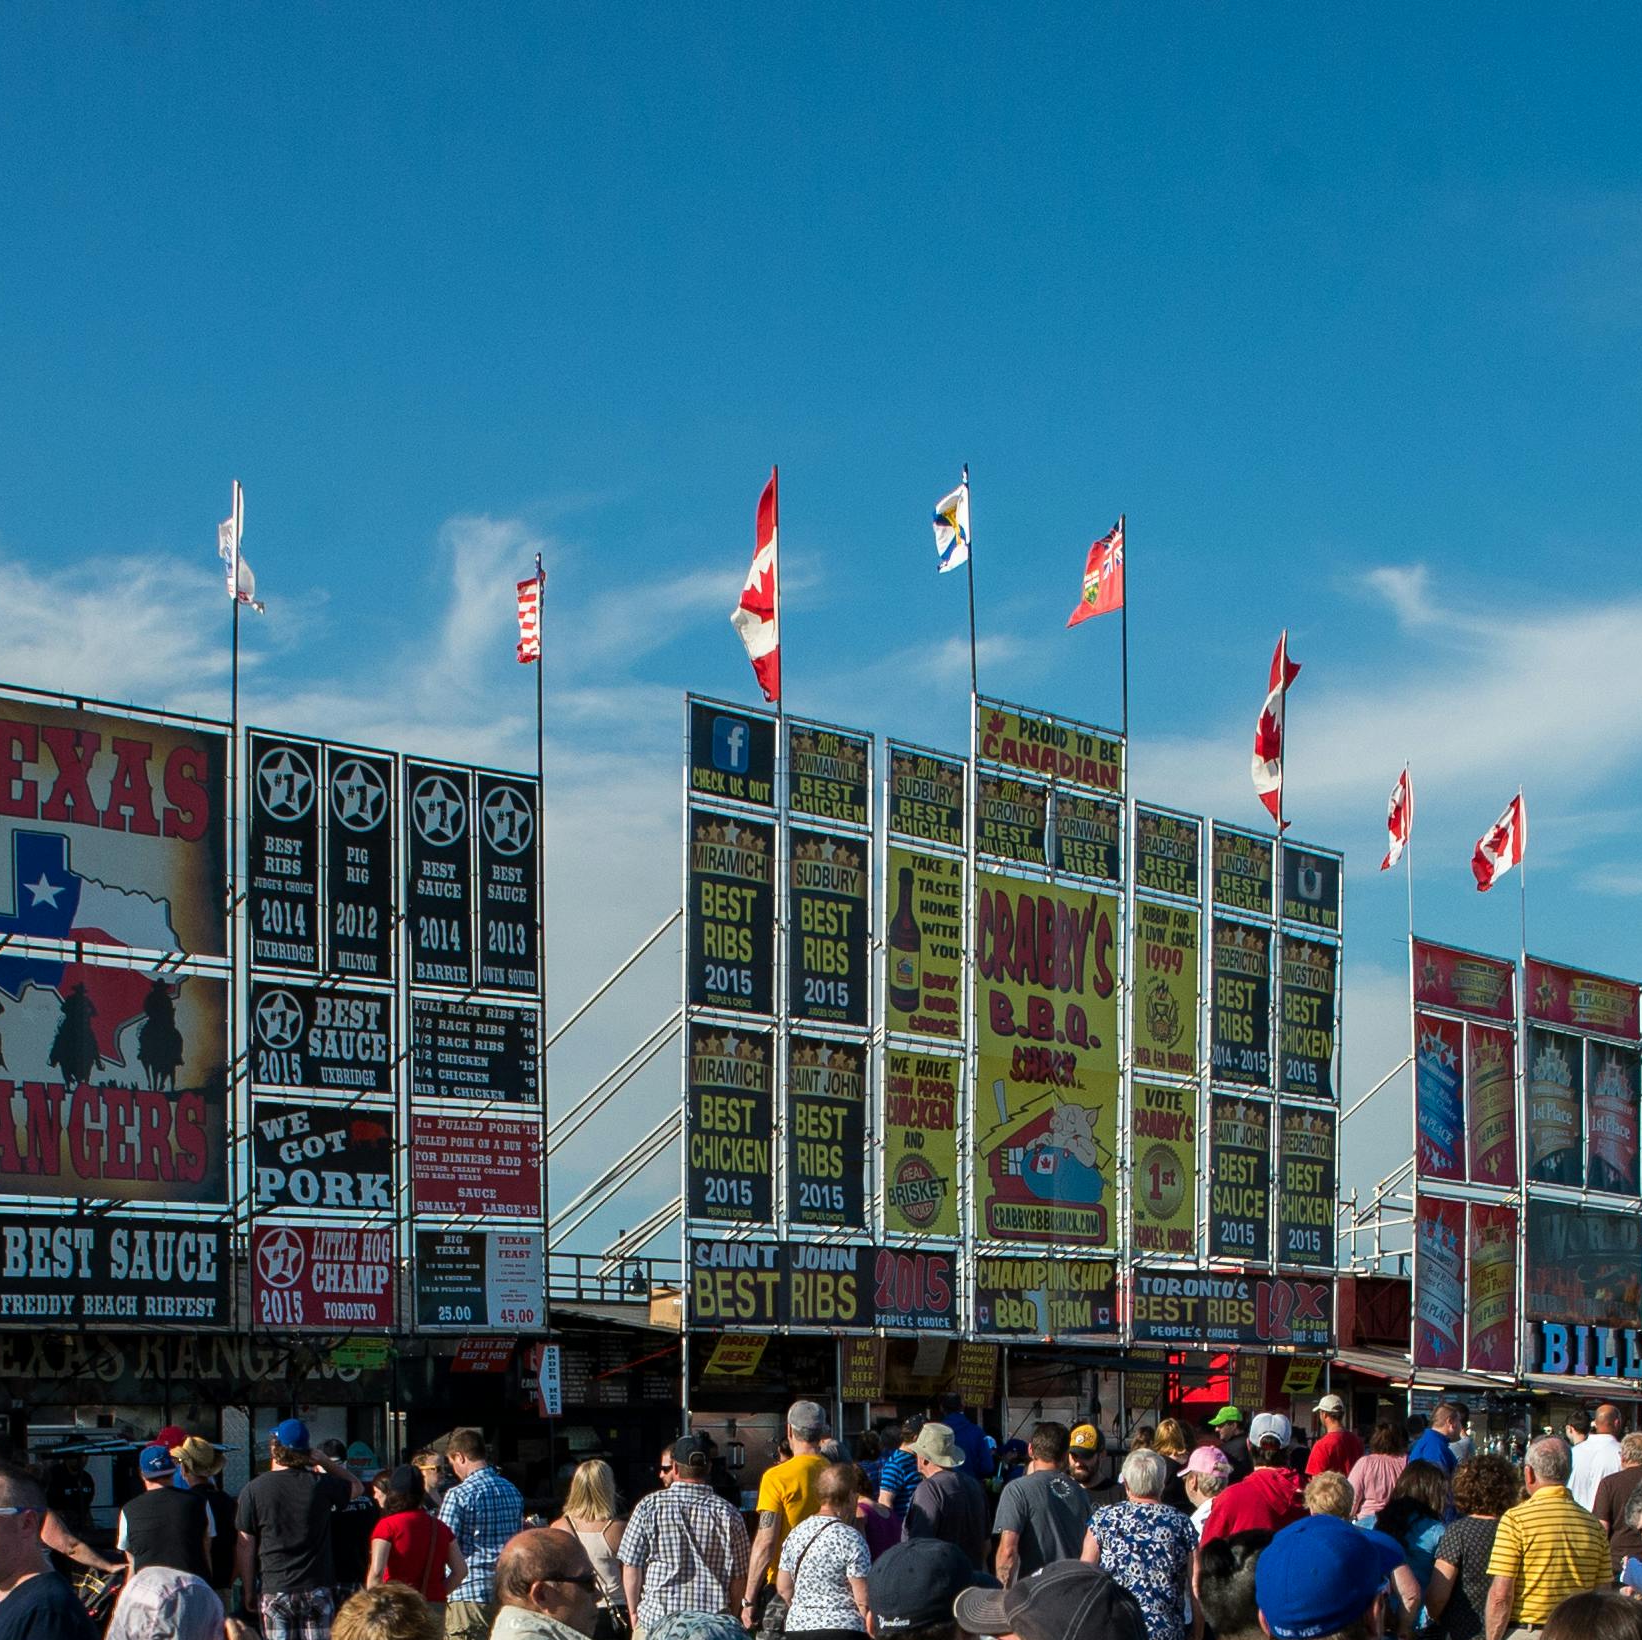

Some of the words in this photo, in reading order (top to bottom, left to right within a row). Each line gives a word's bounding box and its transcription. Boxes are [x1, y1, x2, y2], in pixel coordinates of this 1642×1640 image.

[1018, 715, 1068, 750] PROUD
[1076, 731, 1094, 755] TO
[1099, 739, 1118, 764] BE
[982, 732, 1120, 789] CANADIAN
[692, 767, 726, 792] CHECK
[729, 775, 745, 796] US
[749, 778, 771, 802] OUT
[799, 778, 856, 802] BEST
[791, 791, 867, 823] CHICKEN
[982, 799, 1037, 826] TORONTO
[346, 846, 369, 866] PIG
[693, 843, 771, 881] MIRAMICHI
[1219, 855, 1262, 880] LINDSAY
[346, 866, 370, 886] RIG
[796, 863, 858, 893] SUDBURY
[918, 876, 961, 898] TASTE
[700, 879, 757, 924] BEST
[920, 899, 960, 919] HOME
[336, 901, 378, 940] 2012
[922, 921, 960, 939] WITH
[704, 921, 754, 964] RIBS
[930, 942, 959, 960] YOU
[977, 886, 1115, 1000] CRABBY'S
[337, 951, 378, 973] MILTON
[415, 961, 468, 983] BARRIE
[1145, 942, 1183, 977] 1999
[704, 962, 753, 996] 2015
[315, 996, 382, 1031] BEST
[308, 1028, 388, 1063] SAUCE
[257, 1050, 302, 1086] 2015
[320, 1066, 377, 1087] UXBRIDGE
[1144, 1088, 1183, 1111] VOTE
[258, 1110, 310, 1142] WE
[279, 1129, 348, 1165] GOT
[691, 1135, 768, 1175] CHICKEN
[258, 1167, 391, 1208] PORK
[888, 1176, 949, 1207] BRISKET
[1213, 1185, 1265, 1219] SAUCE
[1279, 1193, 1333, 1227] CHICKEN
[2, 1226, 95, 1280] BEST
[109, 1228, 219, 1283] SAUCE
[311, 1230, 357, 1261] LITTLE
[362, 1231, 391, 1261] HOG
[695, 1243, 781, 1269] SAINT
[791, 1247, 857, 1271] JOHN
[311, 1262, 390, 1295] CHAMP
[873, 1248, 952, 1313] 2015
[1138, 1275, 1249, 1299] TORONTO'S
[0, 1293, 76, 1316] FREDDY
[82, 1295, 139, 1316] BEACH
[145, 1297, 217, 1318] RIBFEST
[261, 1290, 304, 1324] 2015
[324, 1302, 377, 1321] TORONTO
[694, 1269, 781, 1320] BEST
[790, 1271, 857, 1322] RIBS
[1133, 1296, 1205, 1322] BEST
[1207, 1299, 1255, 1325] RIBS
[995, 1298, 1038, 1329] BBQ
[1049, 1296, 1092, 1329] TEAM
[718, 1351, 755, 1363] HERE
[719, 1335, 766, 1347] ORDER
